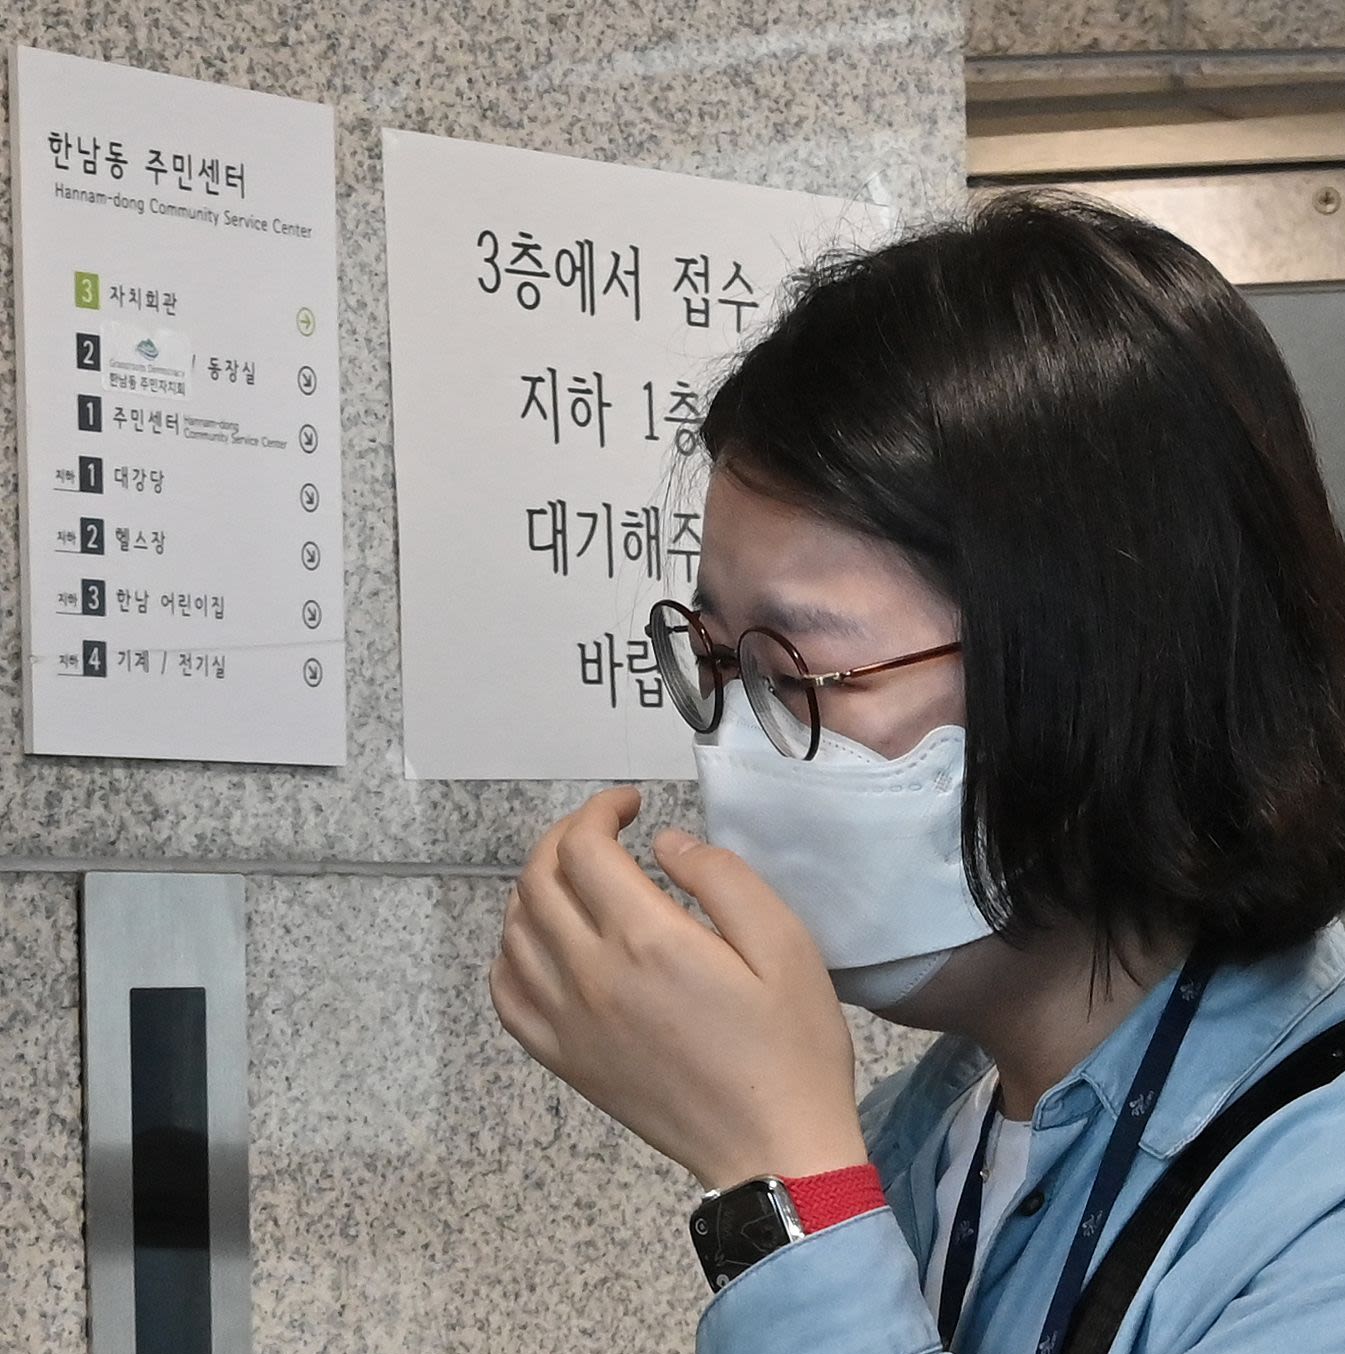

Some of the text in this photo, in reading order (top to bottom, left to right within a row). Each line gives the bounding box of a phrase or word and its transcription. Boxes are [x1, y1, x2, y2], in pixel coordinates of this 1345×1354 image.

[47, 130, 247, 199] 한남동 주민센터
[54, 182, 313, 240] Hannam-dong Community Service Center
[82, 278, 178, 317] 3 자치회관
[476, 228, 761, 334] 3층에서 접수
[83, 339, 95, 366] 2
[207, 356, 256, 386] 동장실
[109, 372, 137, 391] 한남동
[85, 401, 180, 436] 1 주민센터
[520, 366, 704, 458] 지하 1층
[87, 461, 97, 488] 1
[113, 465, 165, 495] 대강당
[86, 523, 99, 550] 2
[115, 526, 166, 556] 헬스장
[87, 584, 100, 611] 3
[116, 588, 150, 615] 한남
[160, 592, 226, 621] 어린이집
[87, 646, 101, 672] 4
[116, 649, 150, 674] 기계
[178, 653, 227, 681] 전기실
